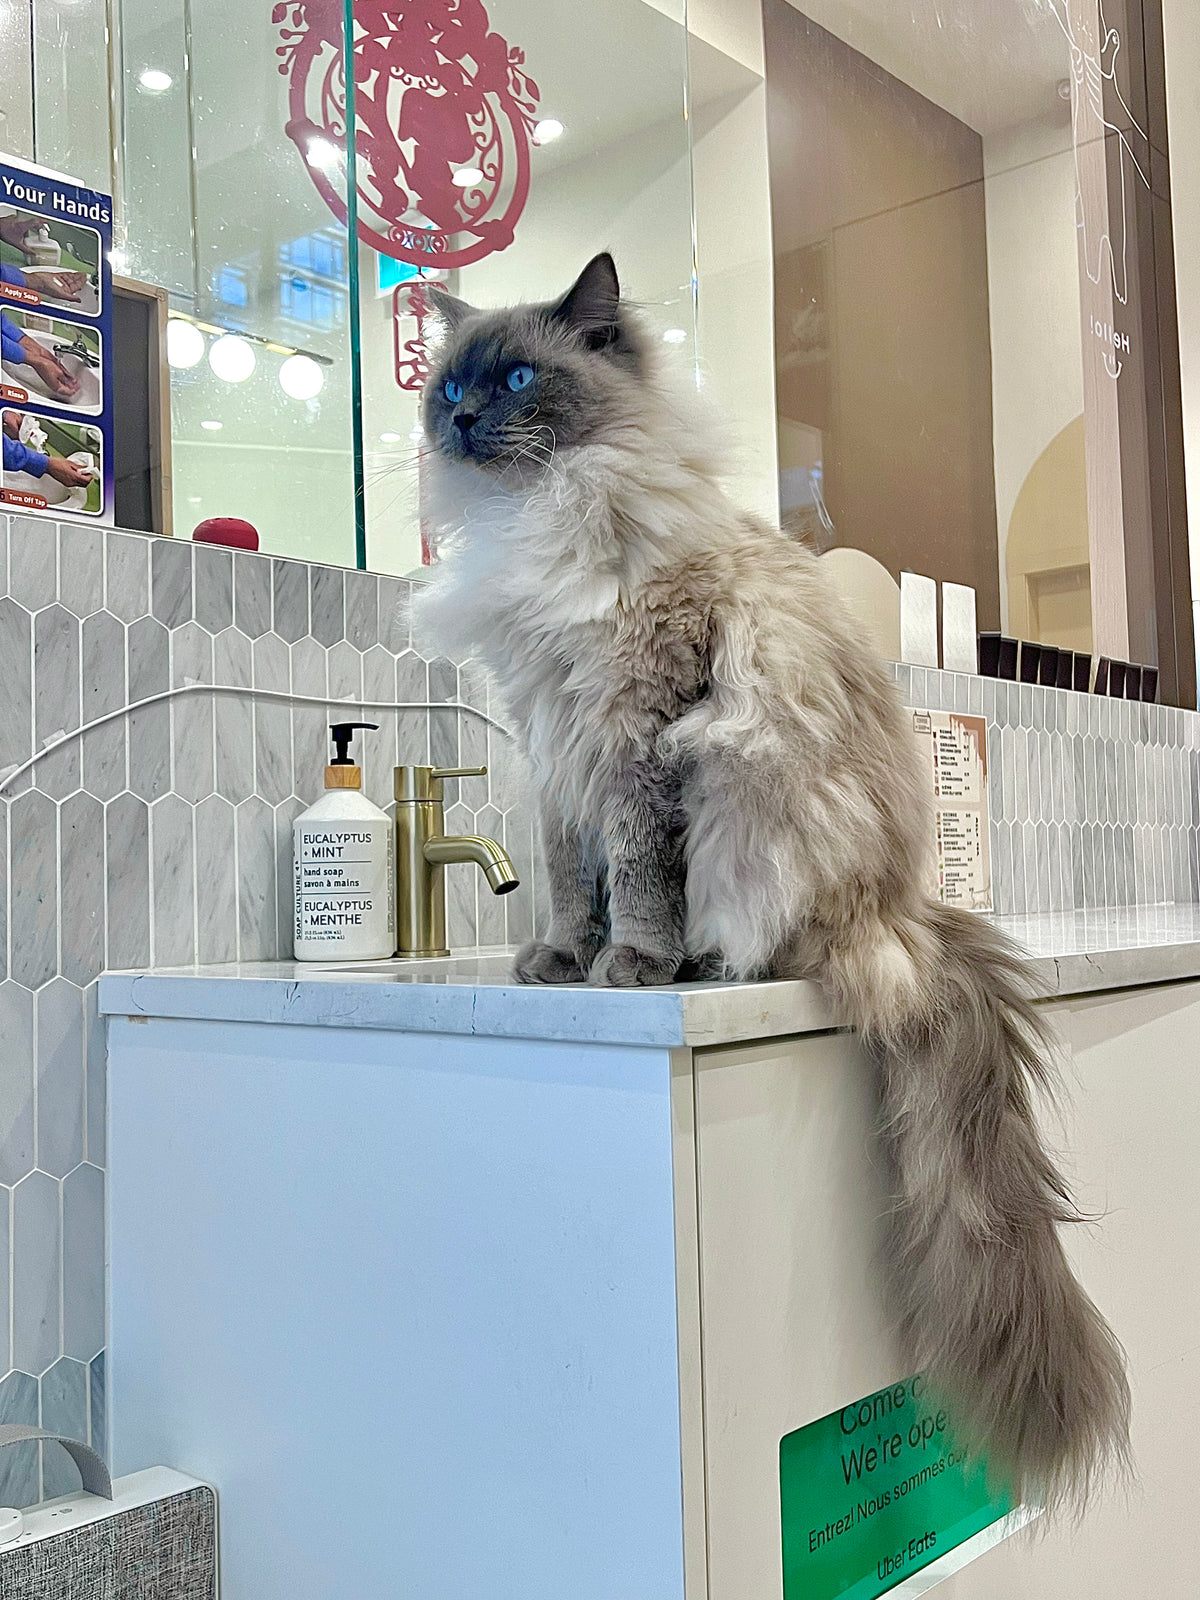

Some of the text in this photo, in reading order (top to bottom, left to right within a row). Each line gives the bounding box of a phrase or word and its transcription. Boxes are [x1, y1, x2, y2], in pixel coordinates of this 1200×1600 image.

[2, 176, 110, 223] Your Hands
[5, 287, 39, 302] Apply Soap
[9, 493, 23, 502] Turn
[23, 496, 34, 504] Off
[35, 499, 46, 508] Tap
[303, 833, 372, 845] EUCALYPTUS
[311, 846, 344, 858] MINT
[303, 867, 344, 878] hand soap
[326, 879, 332, 887] à
[333, 879, 360, 887] mains
[304, 900, 373, 912] EUCALYPTUS
[310, 913, 362, 926] MENTHE
[840, 1384, 906, 1435] Come
[840, 1433, 902, 1486] We're
[908, 1409, 950, 1451] ope
[808, 1458, 945, 1554] Entrez! Nous sommes
[877, 1530, 937, 1581] Uber Eats
